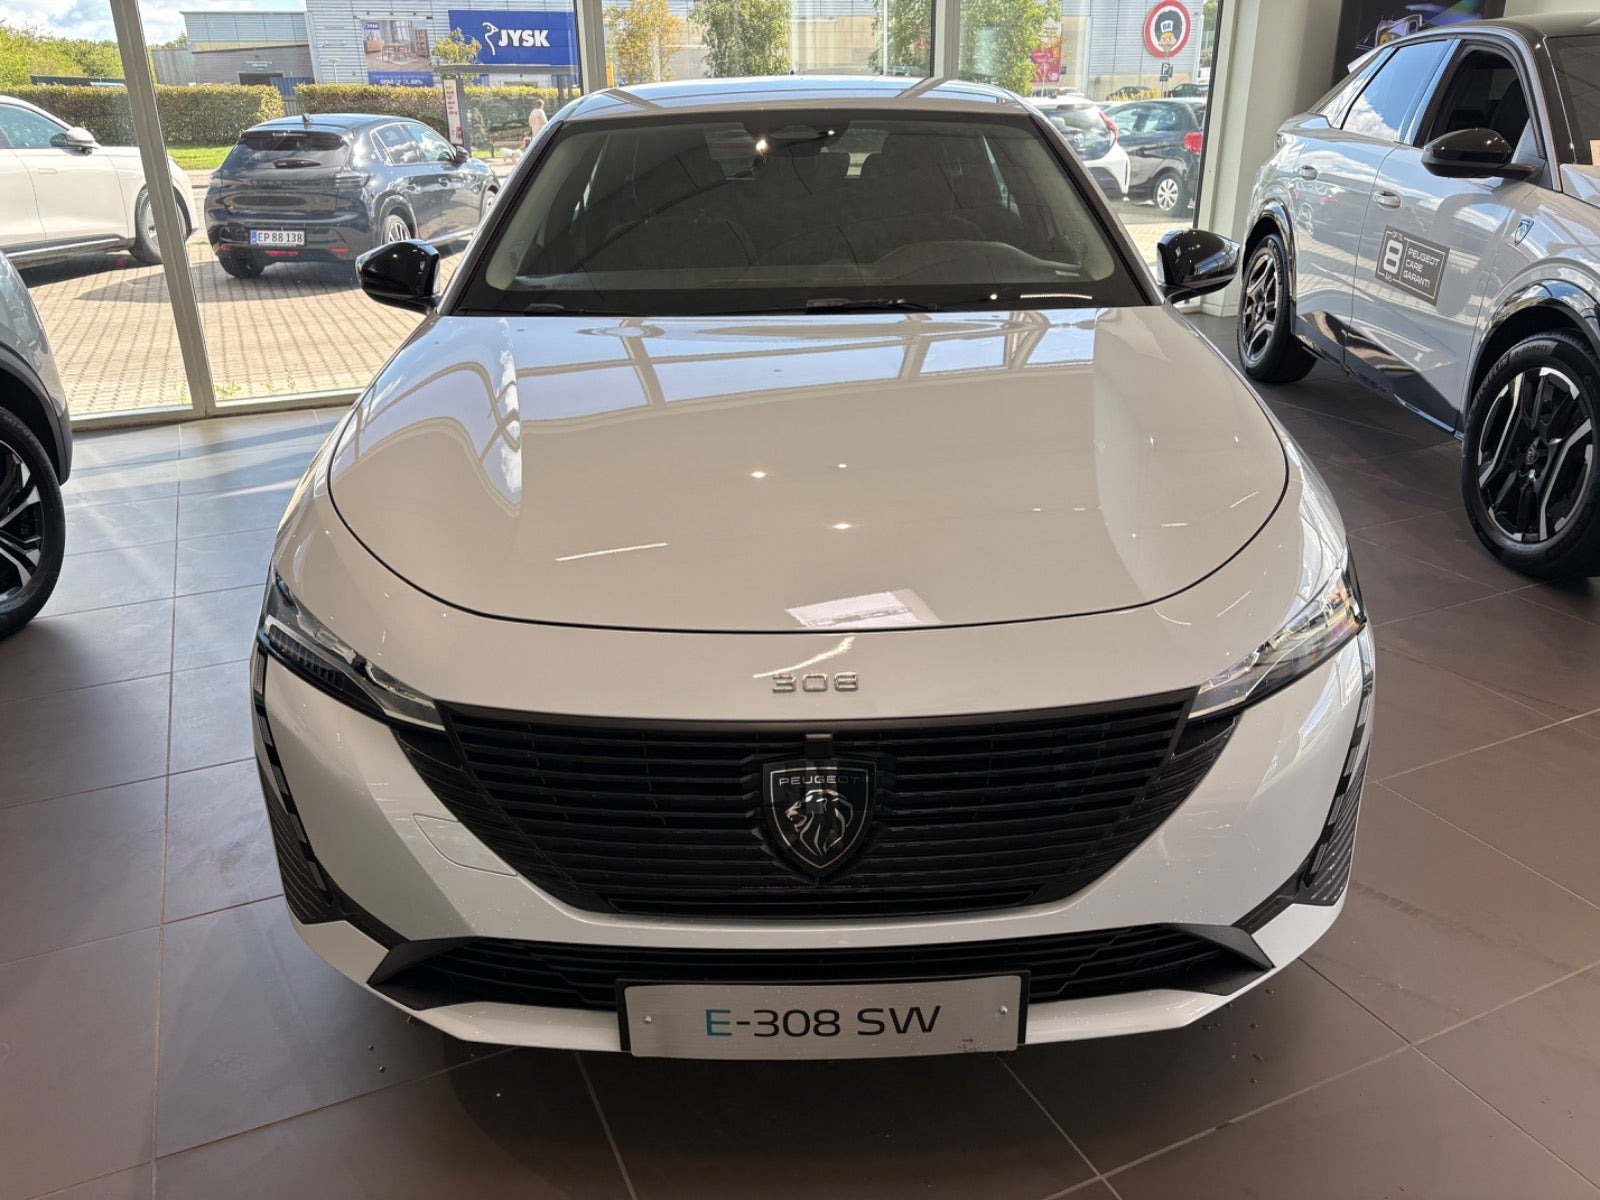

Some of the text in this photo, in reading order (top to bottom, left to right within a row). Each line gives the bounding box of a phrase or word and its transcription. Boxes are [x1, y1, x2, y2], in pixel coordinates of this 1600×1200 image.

[498, 30, 550, 47] JYSK
[257, 232, 303, 243] EP 88 138
[1384, 240, 1403, 274] 8
[1405, 258, 1424, 273] CARE
[1408, 248, 1440, 267] PEUGEOT
[772, 672, 858, 693] 308
[779, 774, 861, 787] PEUGEOT
[705, 1005, 941, 1037] E-308 SW
